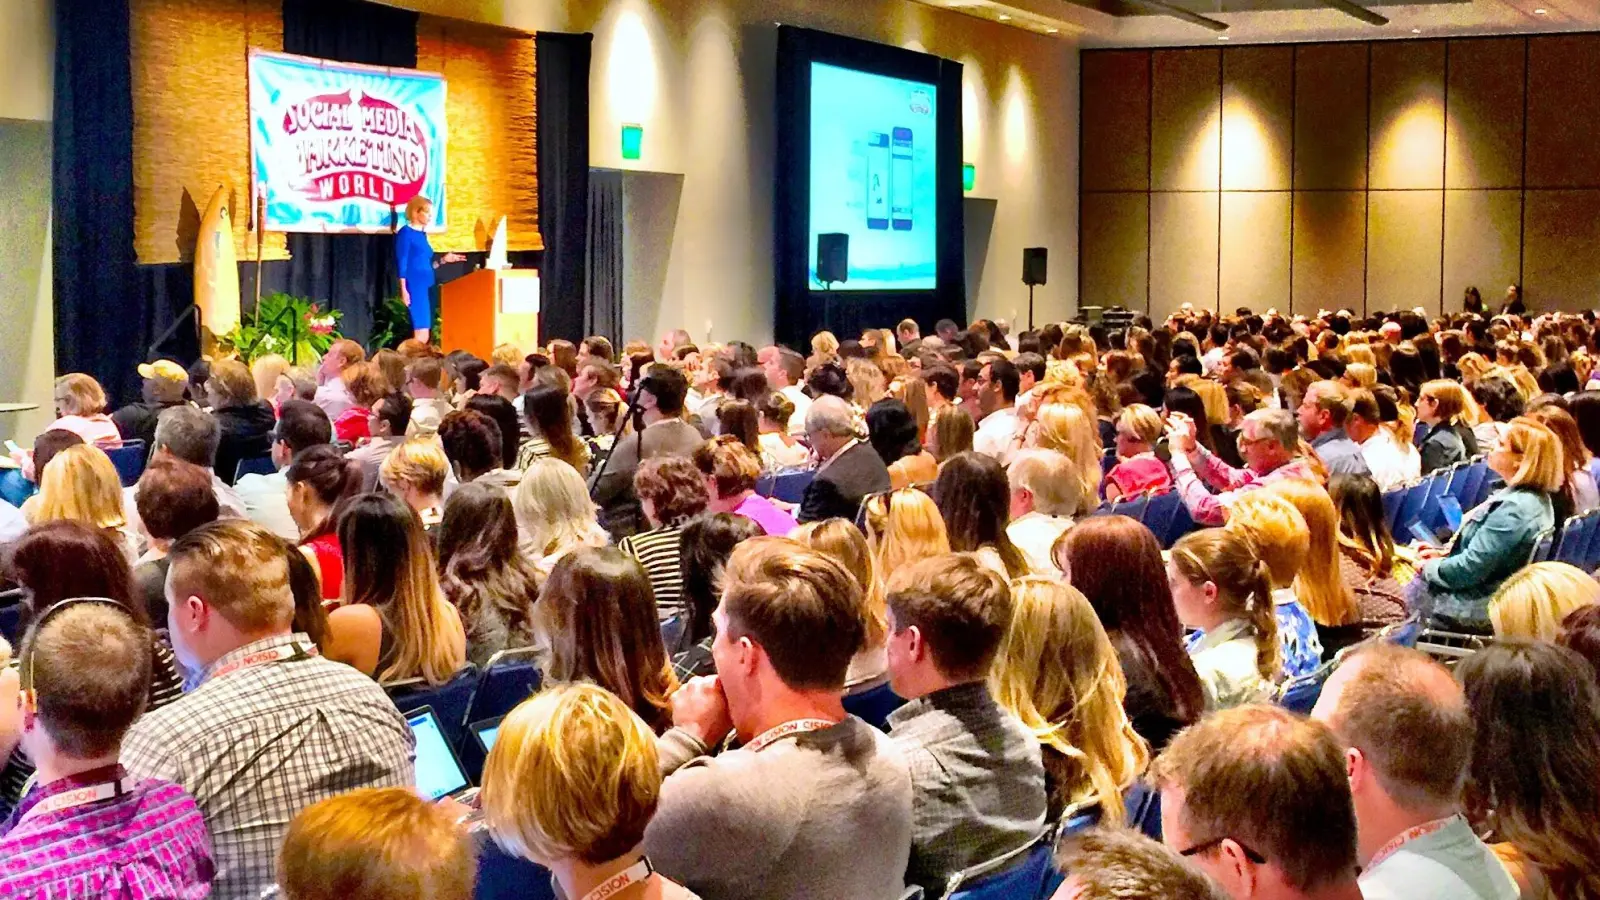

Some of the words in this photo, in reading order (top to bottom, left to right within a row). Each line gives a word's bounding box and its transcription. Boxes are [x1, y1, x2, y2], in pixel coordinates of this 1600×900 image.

[283, 101, 353, 135] SOCIAL
[360, 105, 420, 146] MEDIA
[318, 173, 395, 203] WORLD
[243, 650, 279, 665] CISION
[802, 720, 834, 730] CISIO
[590, 872, 630, 900] CISION
